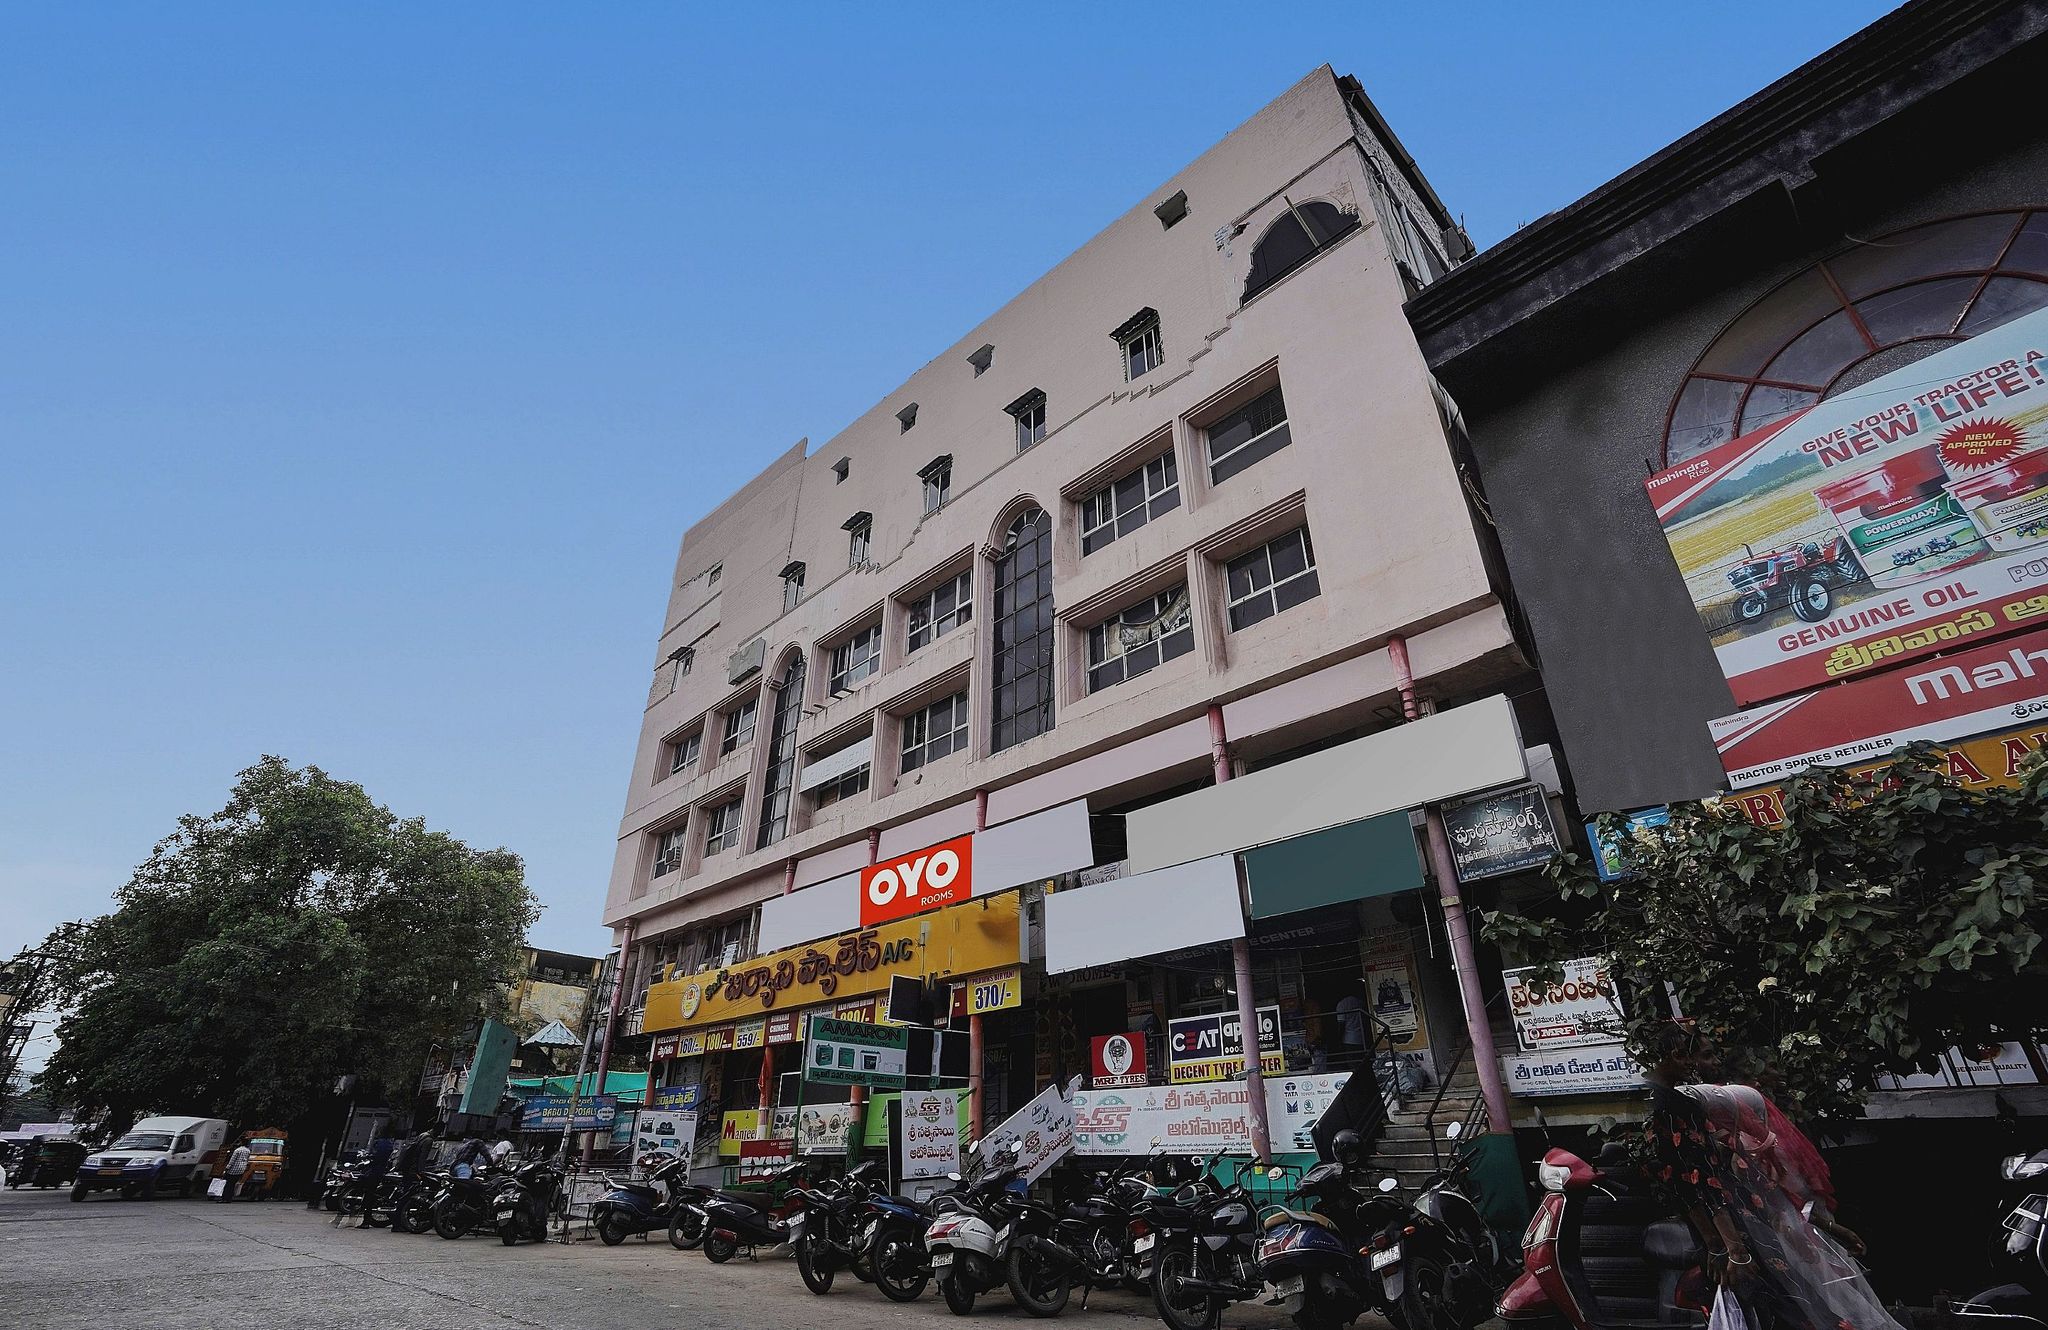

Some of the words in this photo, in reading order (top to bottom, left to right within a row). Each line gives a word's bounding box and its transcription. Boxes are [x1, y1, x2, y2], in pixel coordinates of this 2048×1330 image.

[1801, 428, 1847, 454] GIVE
[1851, 403, 1909, 432] YOUR
[1913, 359, 2020, 407] TRACTOR
[2025, 350, 2044, 364] A
[1816, 412, 1919, 468] NEW
[1931, 364, 2046, 423] LIFE!
[1946, 439, 2012, 450] APPROVED
[1965, 432, 1996, 441] NEW
[1967, 448, 1987, 456] OIL
[1647, 459, 1709, 489] Mahindra
[1777, 599, 1916, 652] GENUINE
[1922, 582, 1979, 608] OIL
[1713, 714, 1749, 728] Mahindra
[1731, 765, 1783, 783] TRACTOR
[1785, 751, 1832, 769] SPARES
[1834, 737, 1894, 760] RETAILER
[869, 849, 960, 906] OYO
[921, 889, 954, 906] ROOMS
[1261, 927, 1316, 944] CENTER
[881, 937, 913, 967] A/C
[975, 982, 1012, 1010] 370/-
[821, 1020, 900, 1041] AMARON
[1223, 1013, 1274, 1042] aplo
[1541, 1028, 1573, 1037] MRF
[706, 1032, 727, 1051] 180/-
[736, 1033, 760, 1047] 559/-
[1172, 1029, 1219, 1052] CEAT
[1174, 1064, 1211, 1079] DECENT
[1213, 1061, 1238, 1076] TYRE
[1515, 1063, 1530, 1079] శ్రీ
[1094, 1076, 1118, 1085] MRF
[1120, 1074, 1145, 1083] TYRES
[1164, 1089, 1181, 1111] శ్రీ
[542, 1108, 561, 1116] BABU
[908, 1124, 916, 1141] శ్రీ
